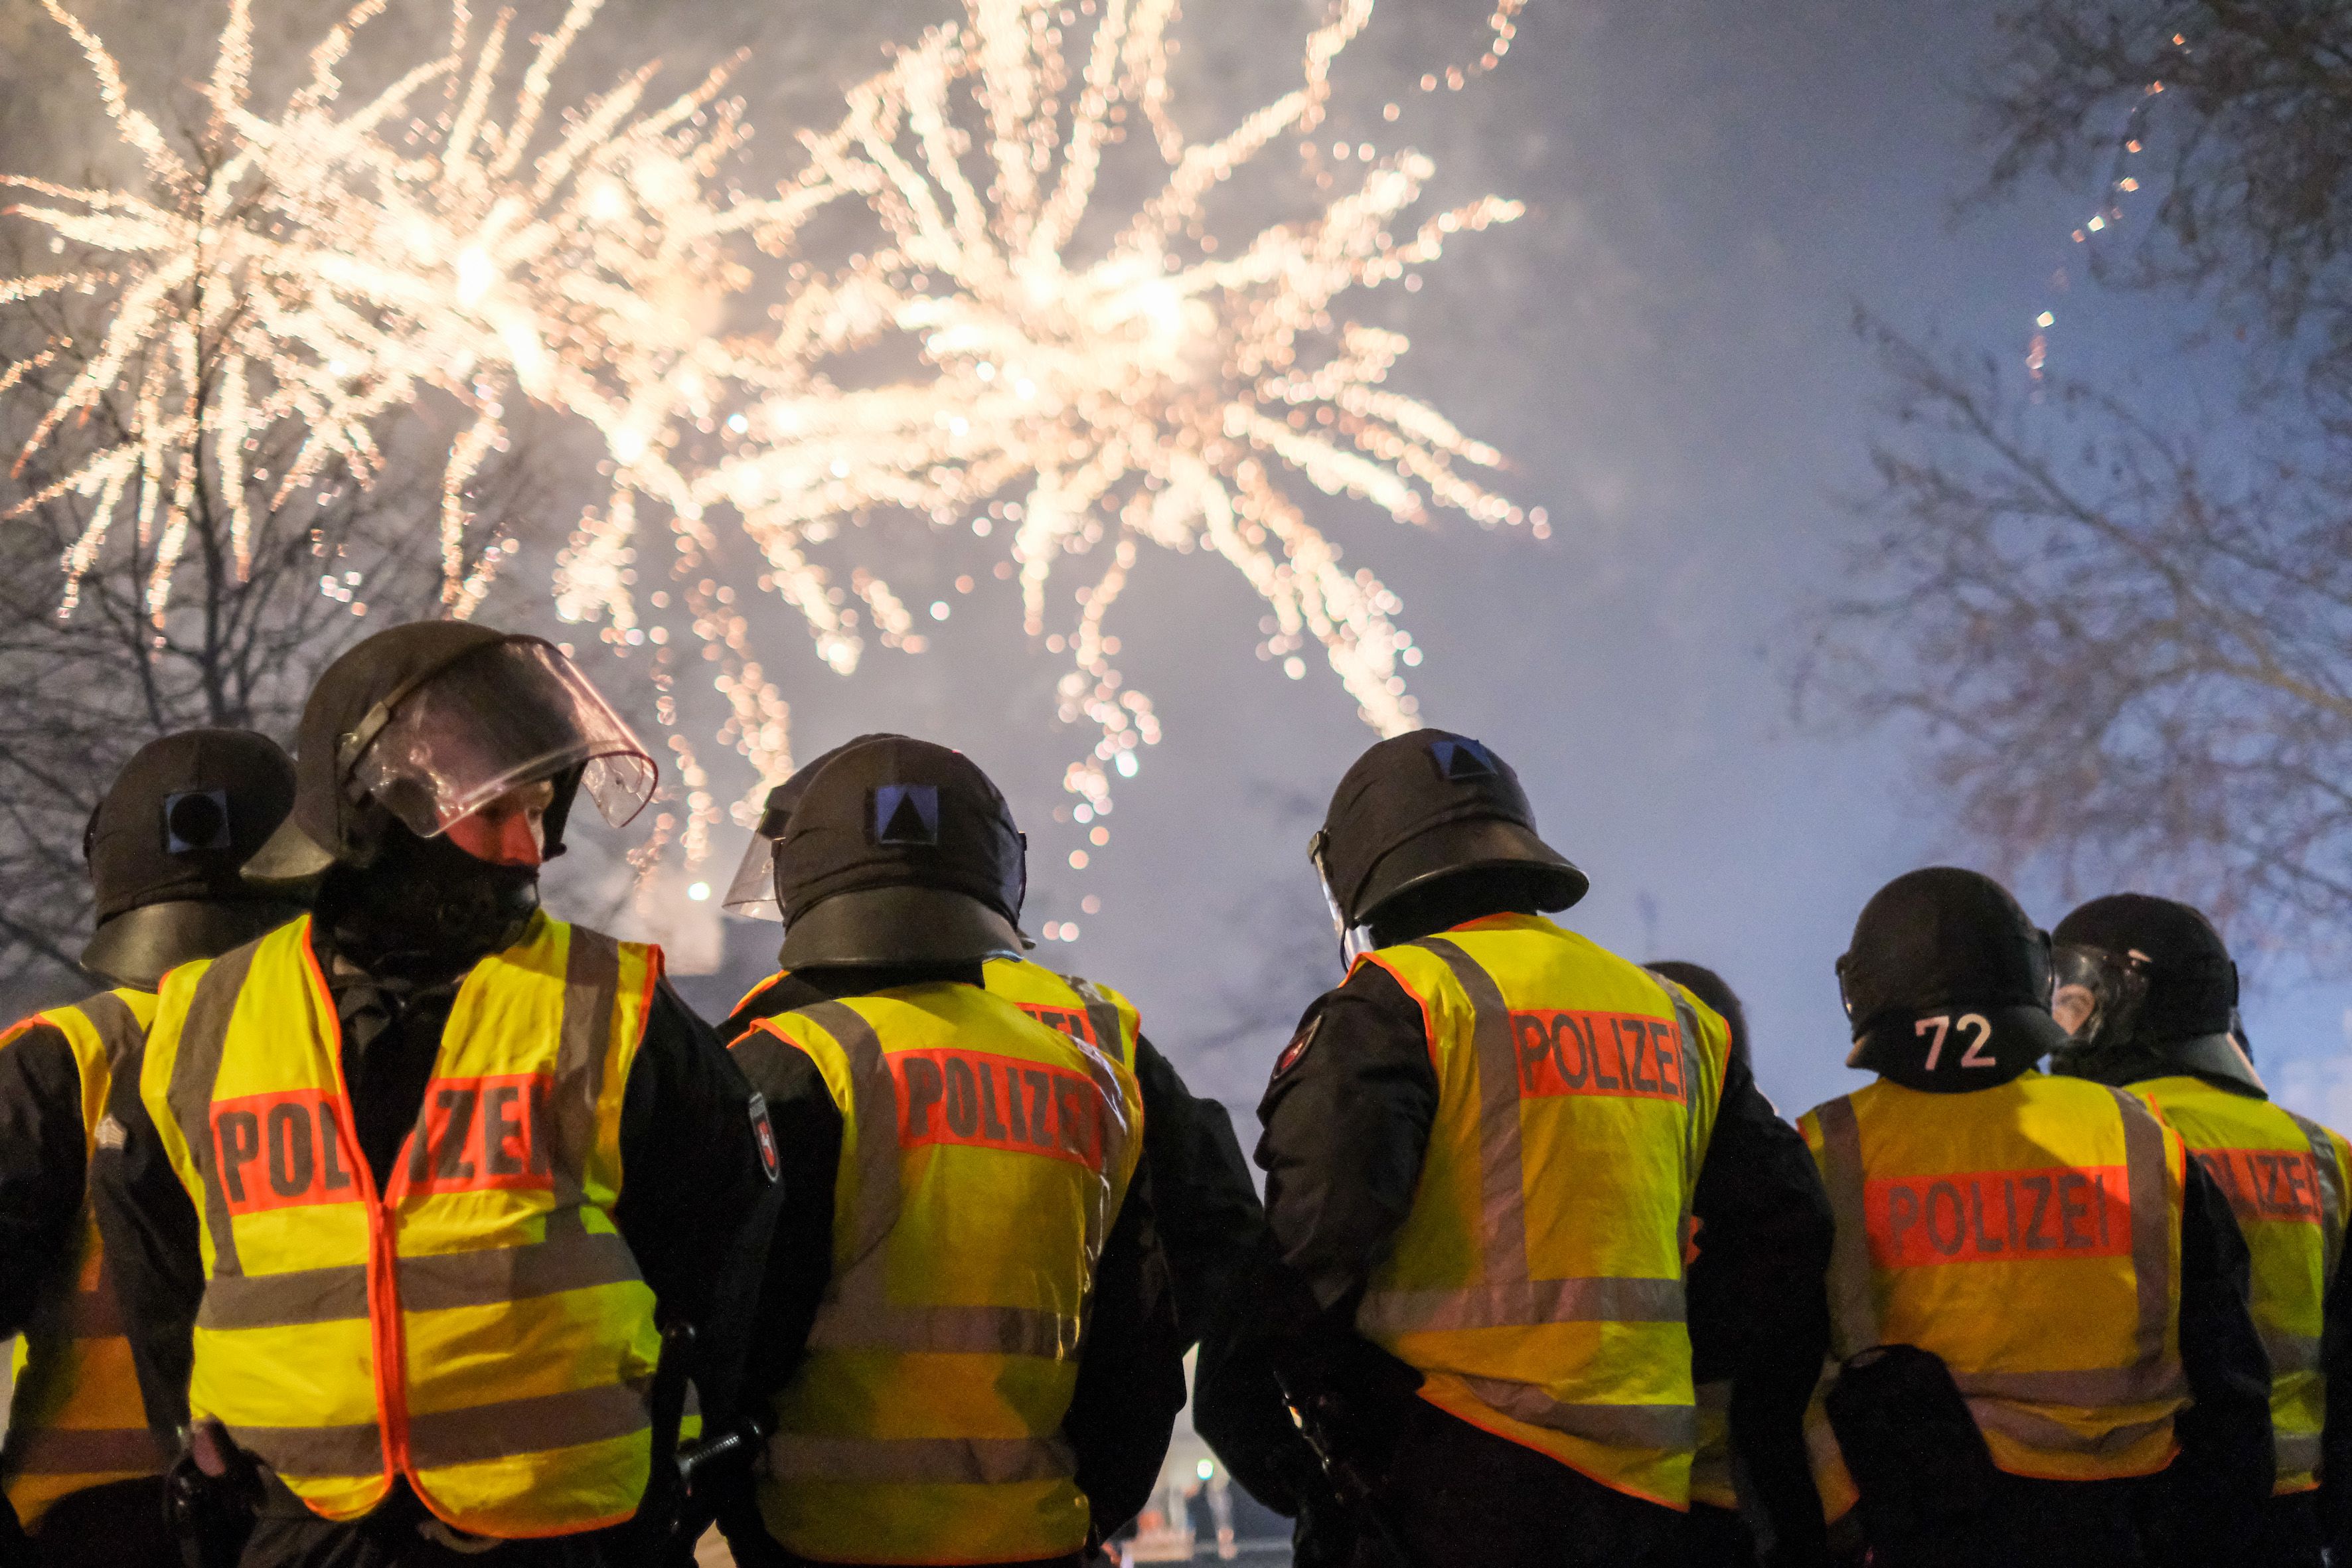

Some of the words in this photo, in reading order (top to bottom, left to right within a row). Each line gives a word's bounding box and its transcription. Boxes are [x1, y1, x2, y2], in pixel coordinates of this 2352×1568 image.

[1514, 1014, 1685, 1099] POLIZEI
[1915, 1013, 1996, 1070] 72
[902, 1057, 1095, 1162] POLIZEI
[1888, 1174, 2110, 1257] POLIZEI
